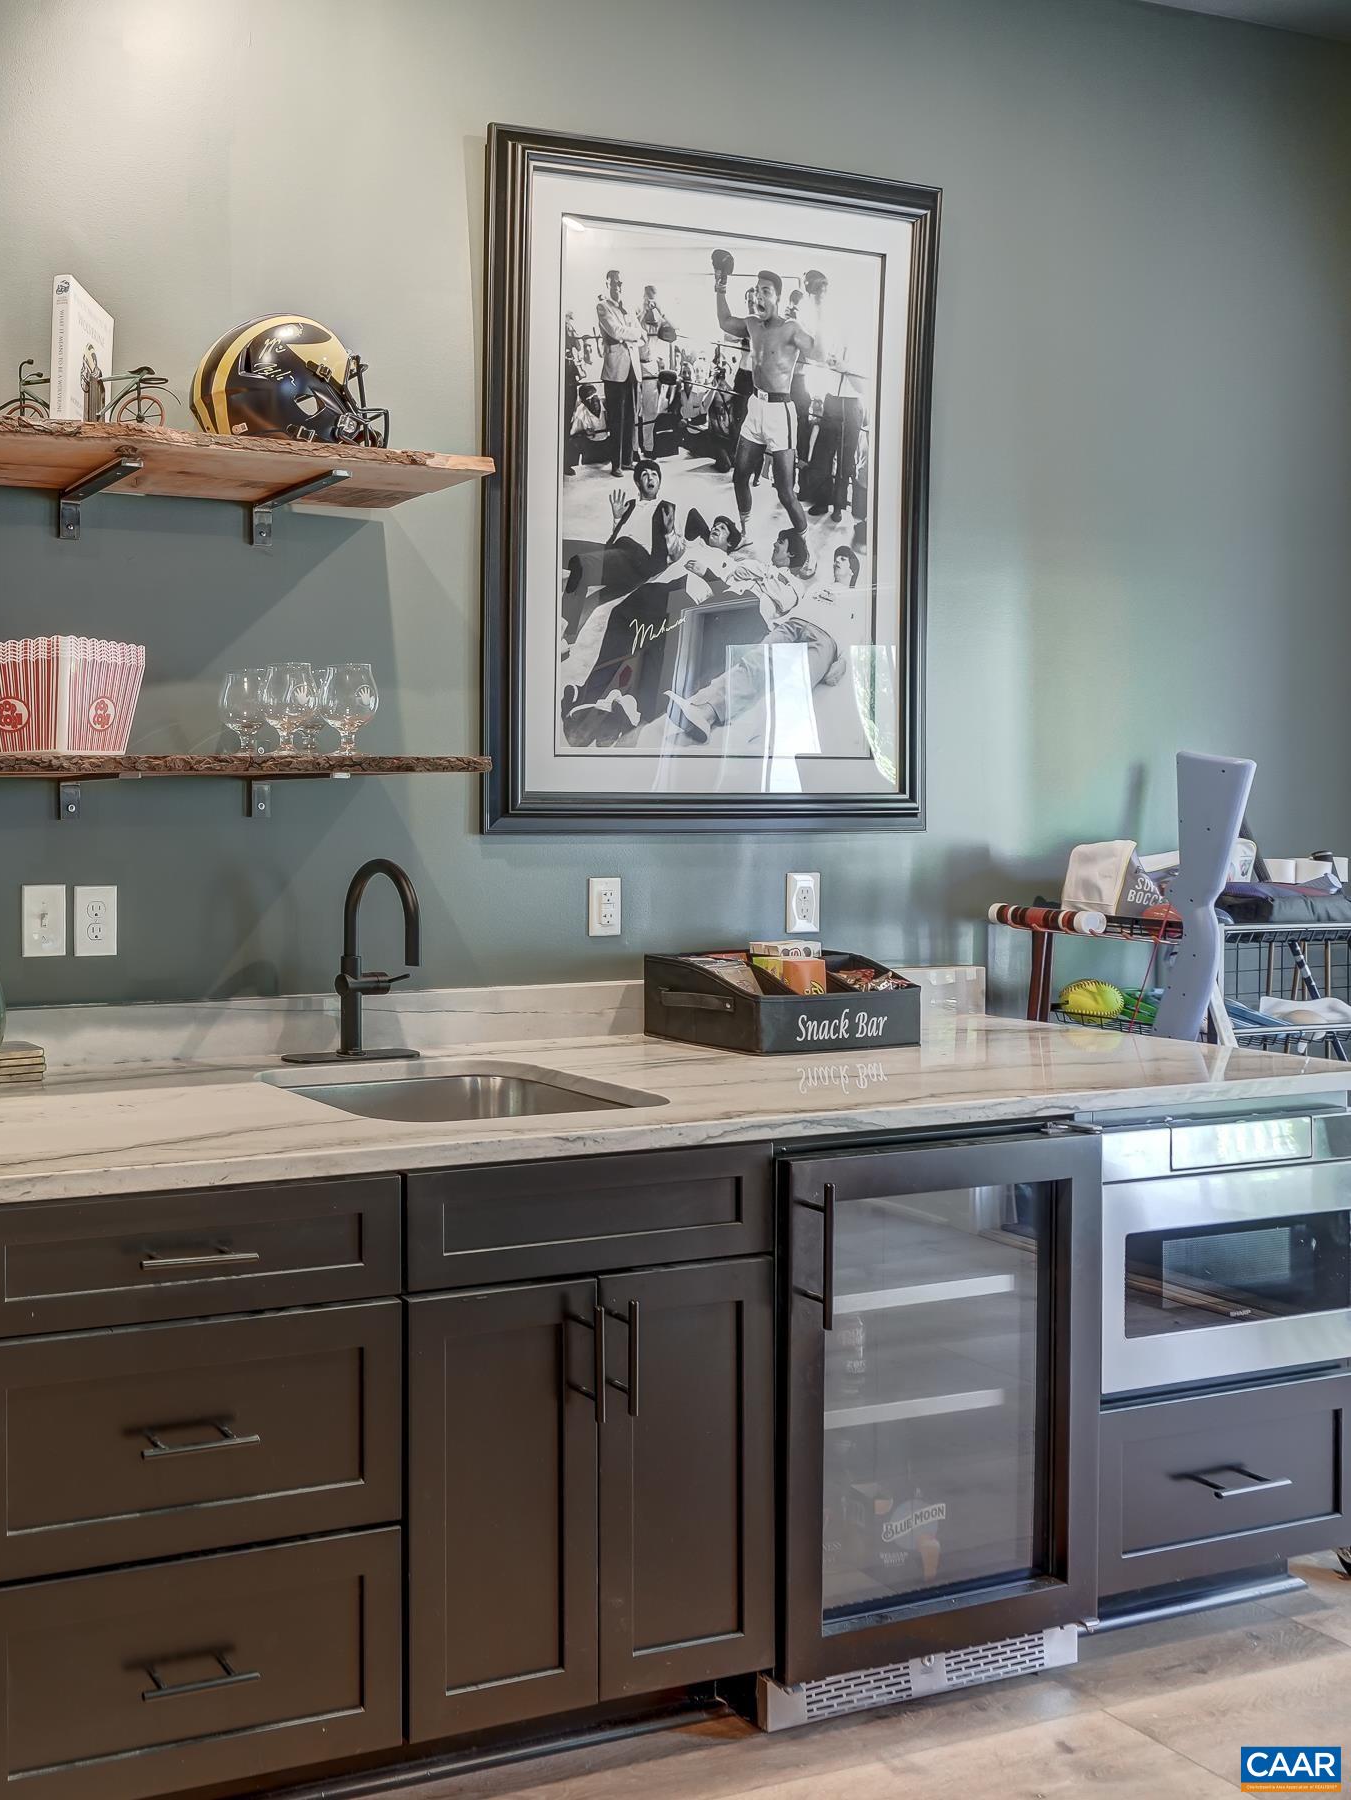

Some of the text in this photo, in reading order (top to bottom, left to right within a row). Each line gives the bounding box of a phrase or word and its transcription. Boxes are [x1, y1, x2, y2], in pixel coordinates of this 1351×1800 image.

[795, 1007, 888, 1042] Snack Bar
[882, 1504, 946, 1541] BLUE MOON
